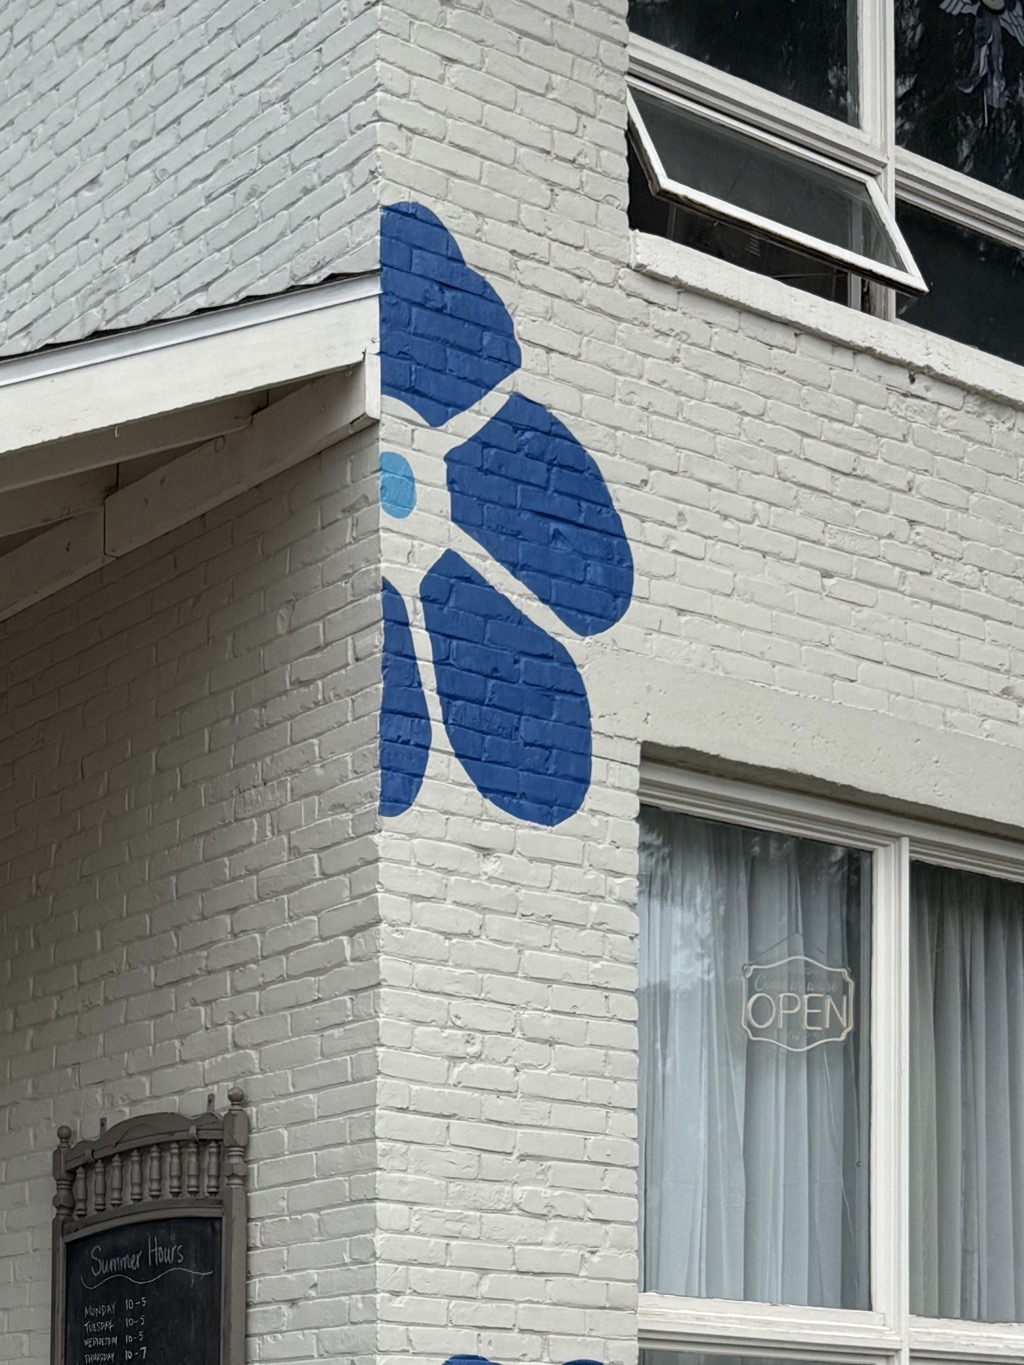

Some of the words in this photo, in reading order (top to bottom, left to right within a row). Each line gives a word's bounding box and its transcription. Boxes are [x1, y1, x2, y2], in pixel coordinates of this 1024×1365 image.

[747, 992, 847, 1031] OPEN
[90, 1245, 143, 1277] Summer
[147, 1235, 184, 1267] Hours
[84, 1301, 116, 1318] MONDAY
[83, 1320, 114, 1334] TUESDAY
